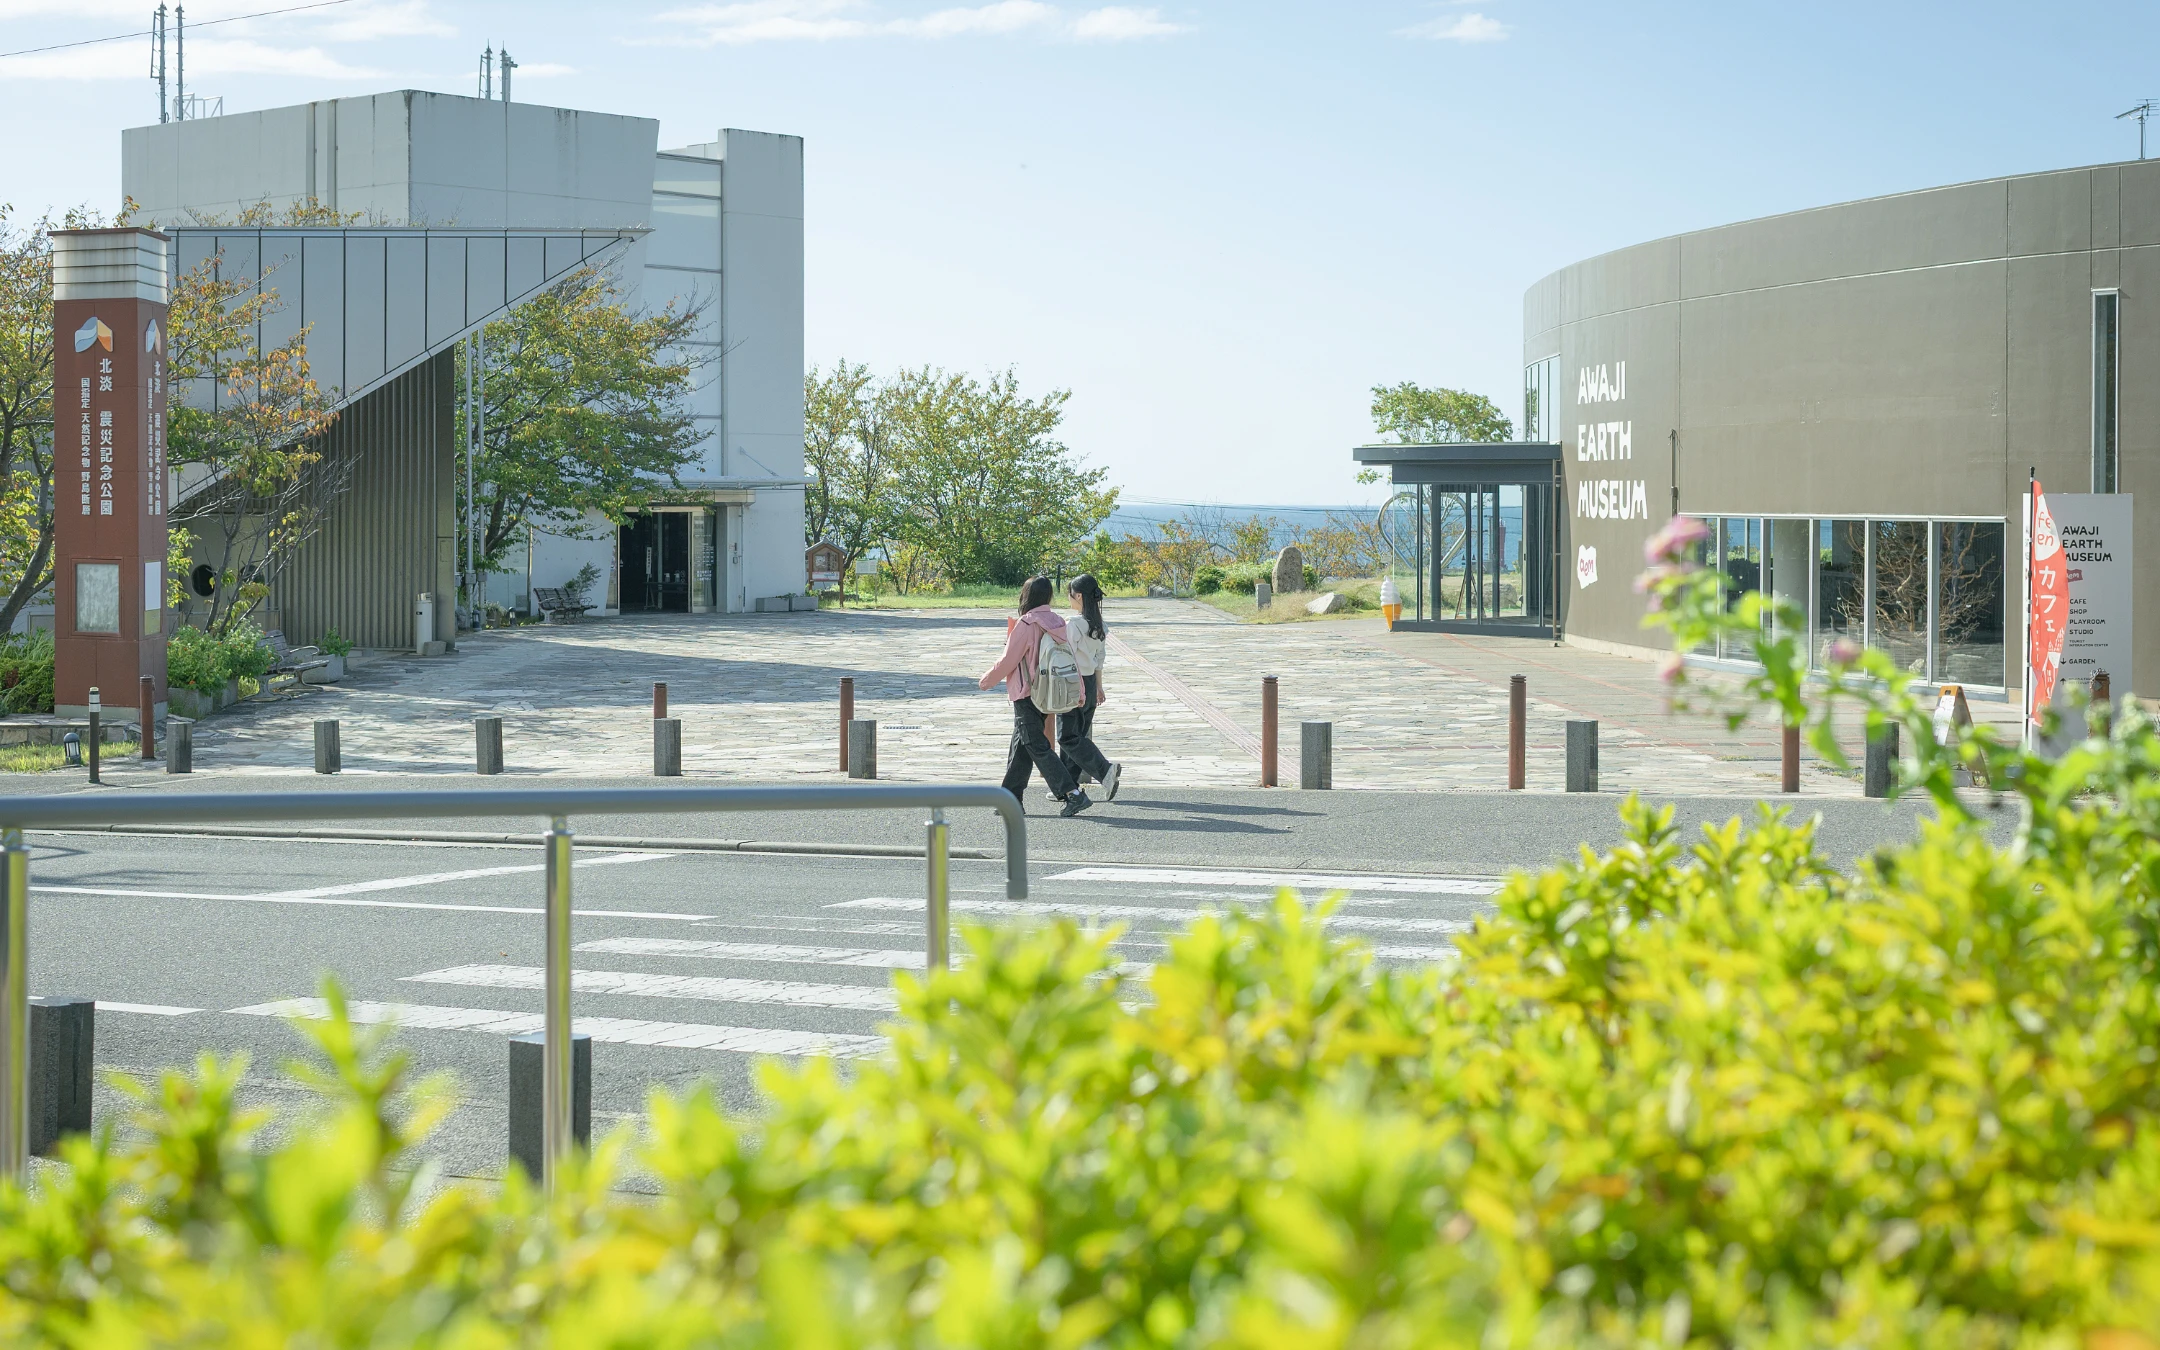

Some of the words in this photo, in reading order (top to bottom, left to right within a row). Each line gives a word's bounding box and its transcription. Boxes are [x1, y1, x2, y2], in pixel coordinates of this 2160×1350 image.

[99, 358, 113, 392] 北淡
[1577, 360, 1626, 405] AWAJI
[1577, 420, 1632, 462] EARTH
[99, 410, 114, 516] 震災記念公園
[1577, 479, 1648, 520] MUSEUM
[2061, 526, 2099, 536] AWAJI
[2062, 539, 2103, 549] EARTH
[2067, 572, 2080, 580] em
[2038, 565, 2057, 633] カフェ
